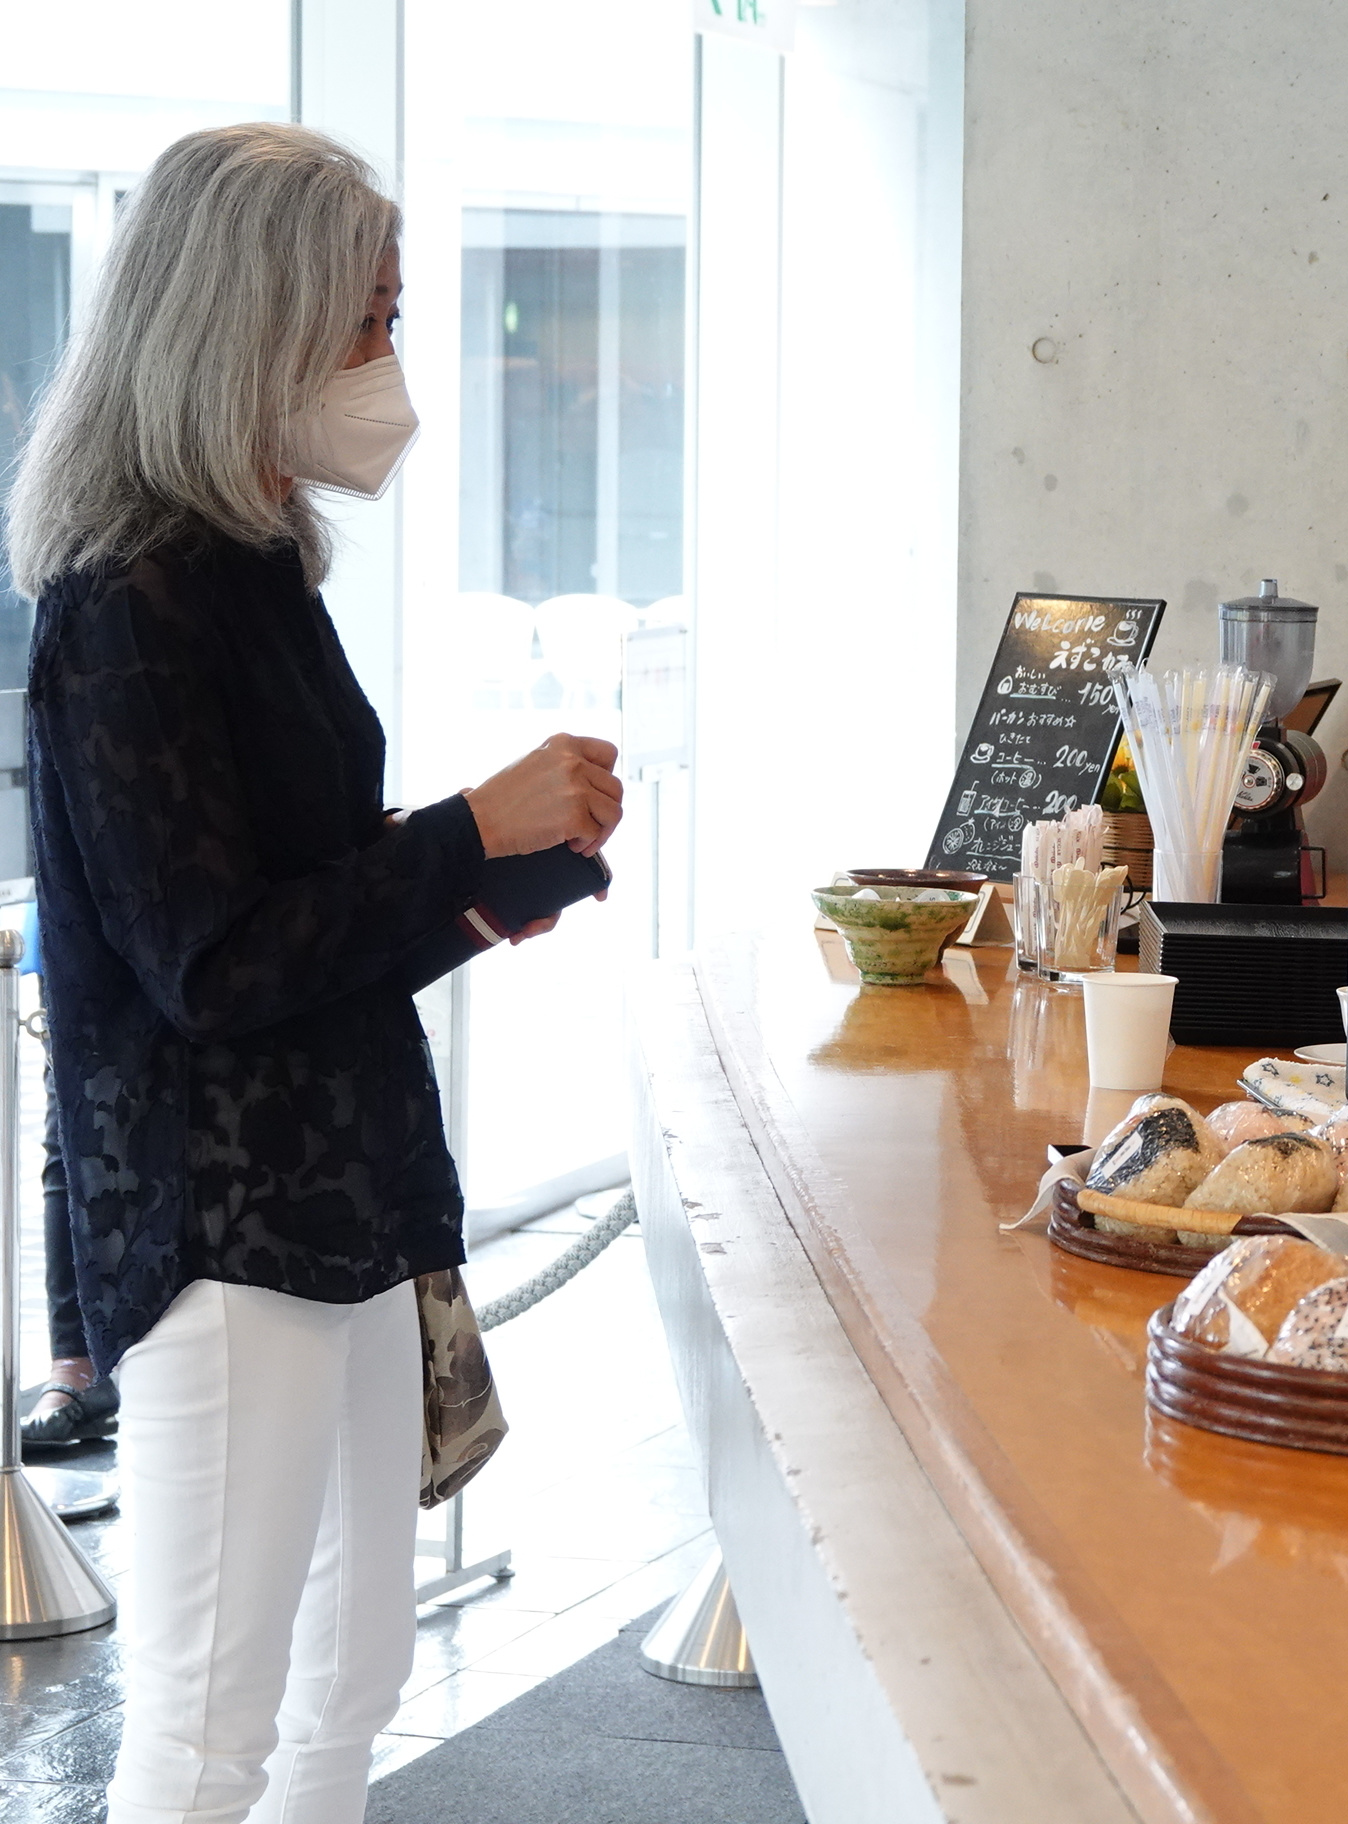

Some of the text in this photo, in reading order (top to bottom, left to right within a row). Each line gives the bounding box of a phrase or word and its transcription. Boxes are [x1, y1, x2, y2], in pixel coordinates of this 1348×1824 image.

[1015, 665, 1046, 679] おいしい
[1078, 681, 1114, 706] 150
[1053, 745, 1088, 768] 200
[1078, 761, 1101, 777] yen
[1041, 789, 1078, 815] 200
[971, 834, 1023, 855] オレンジジュー
